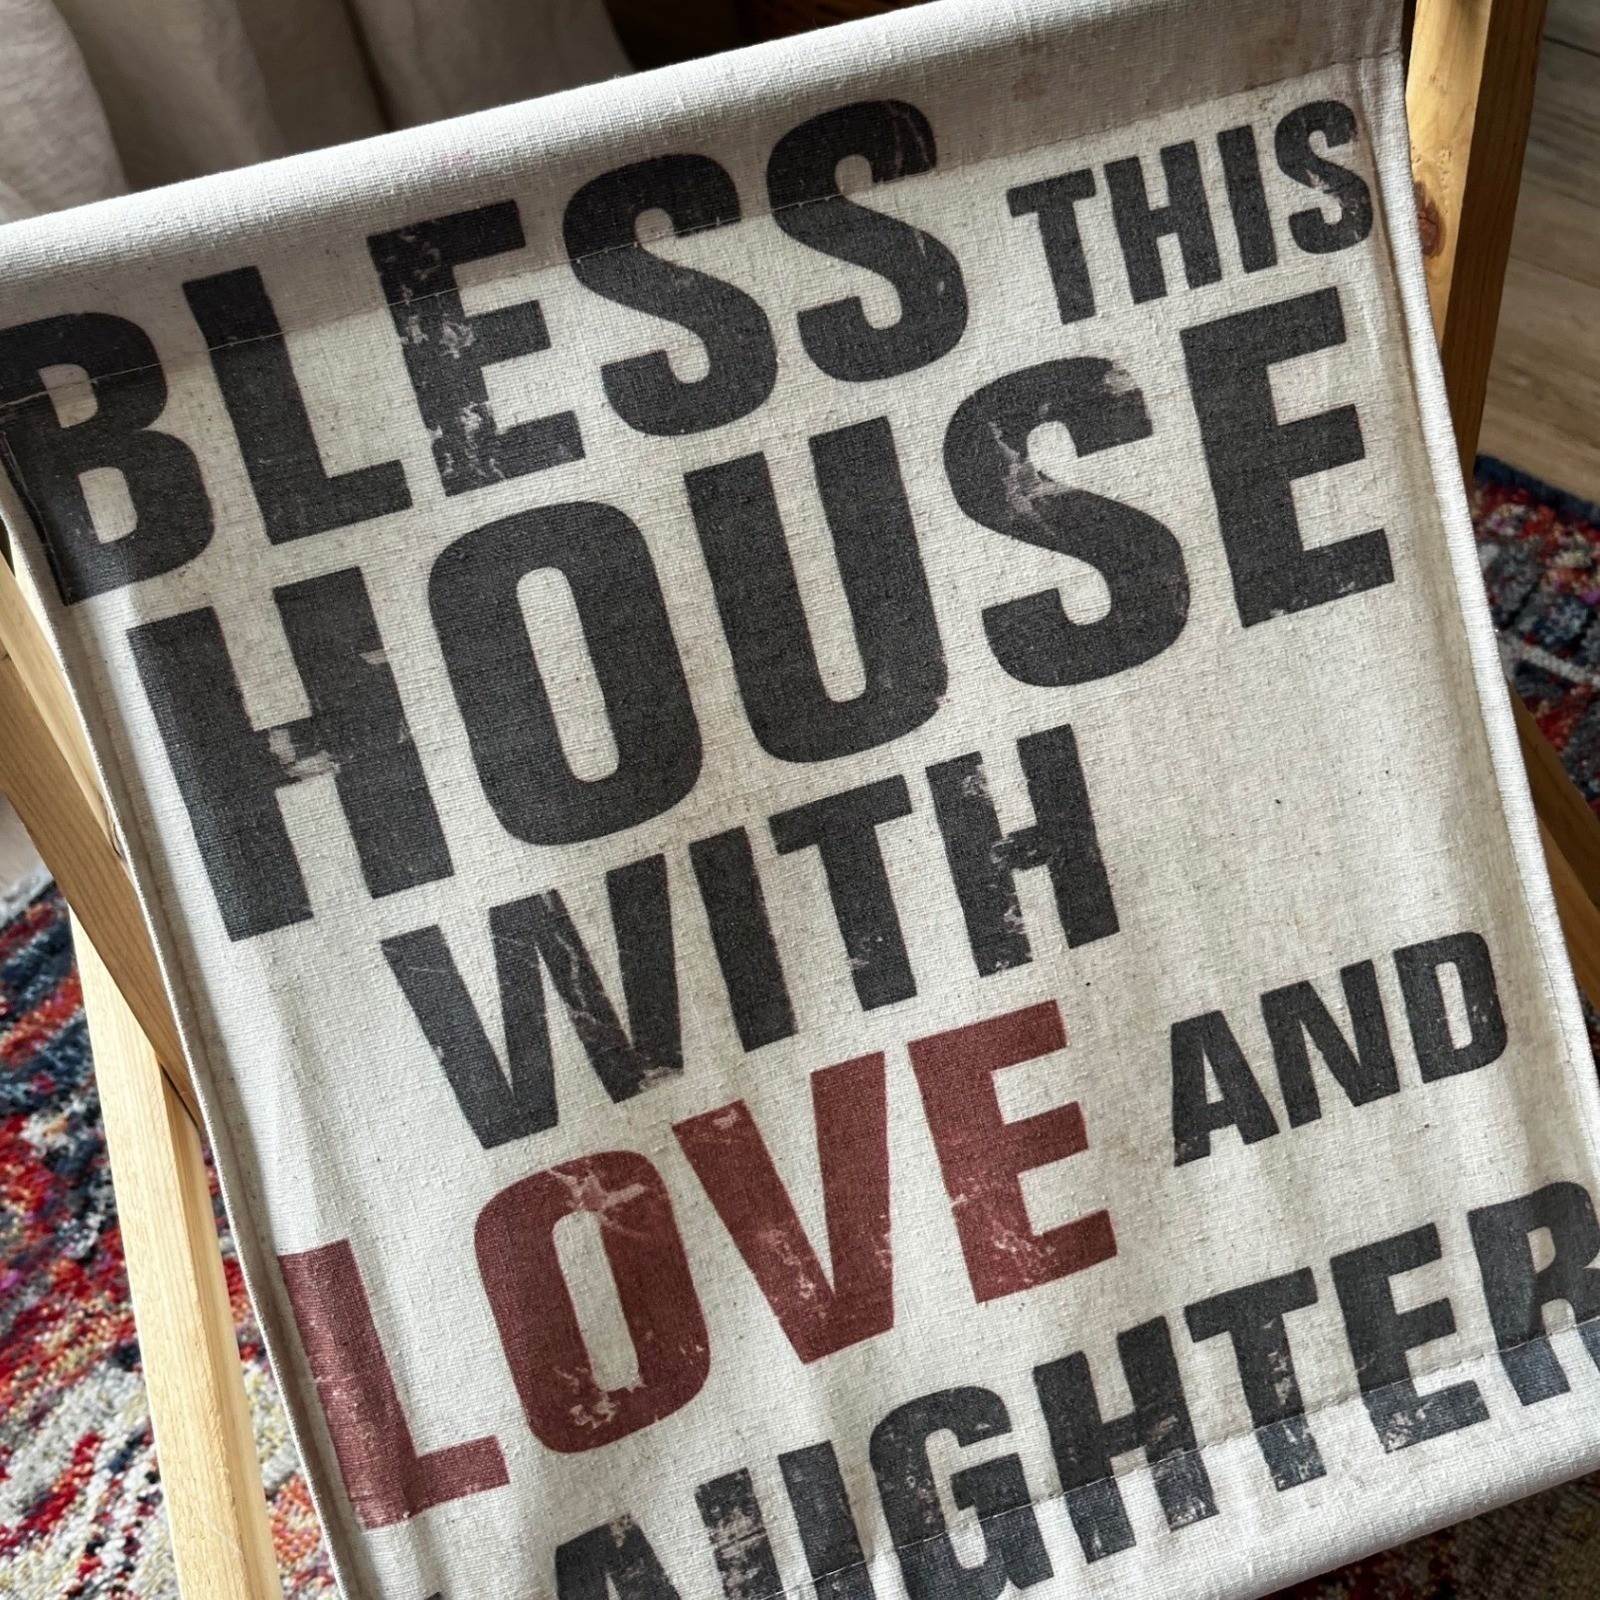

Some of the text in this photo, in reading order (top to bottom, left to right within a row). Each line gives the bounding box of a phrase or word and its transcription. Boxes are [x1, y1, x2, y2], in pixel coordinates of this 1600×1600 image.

[0, 99, 1374, 605] BLESS THIS
[126, 286, 1394, 942] HOUSE
[381, 724, 1121, 1149] WITH
[277, 931, 1508, 1531] LOVE AND
[421, 1181, 1600, 1600] UGHTER
